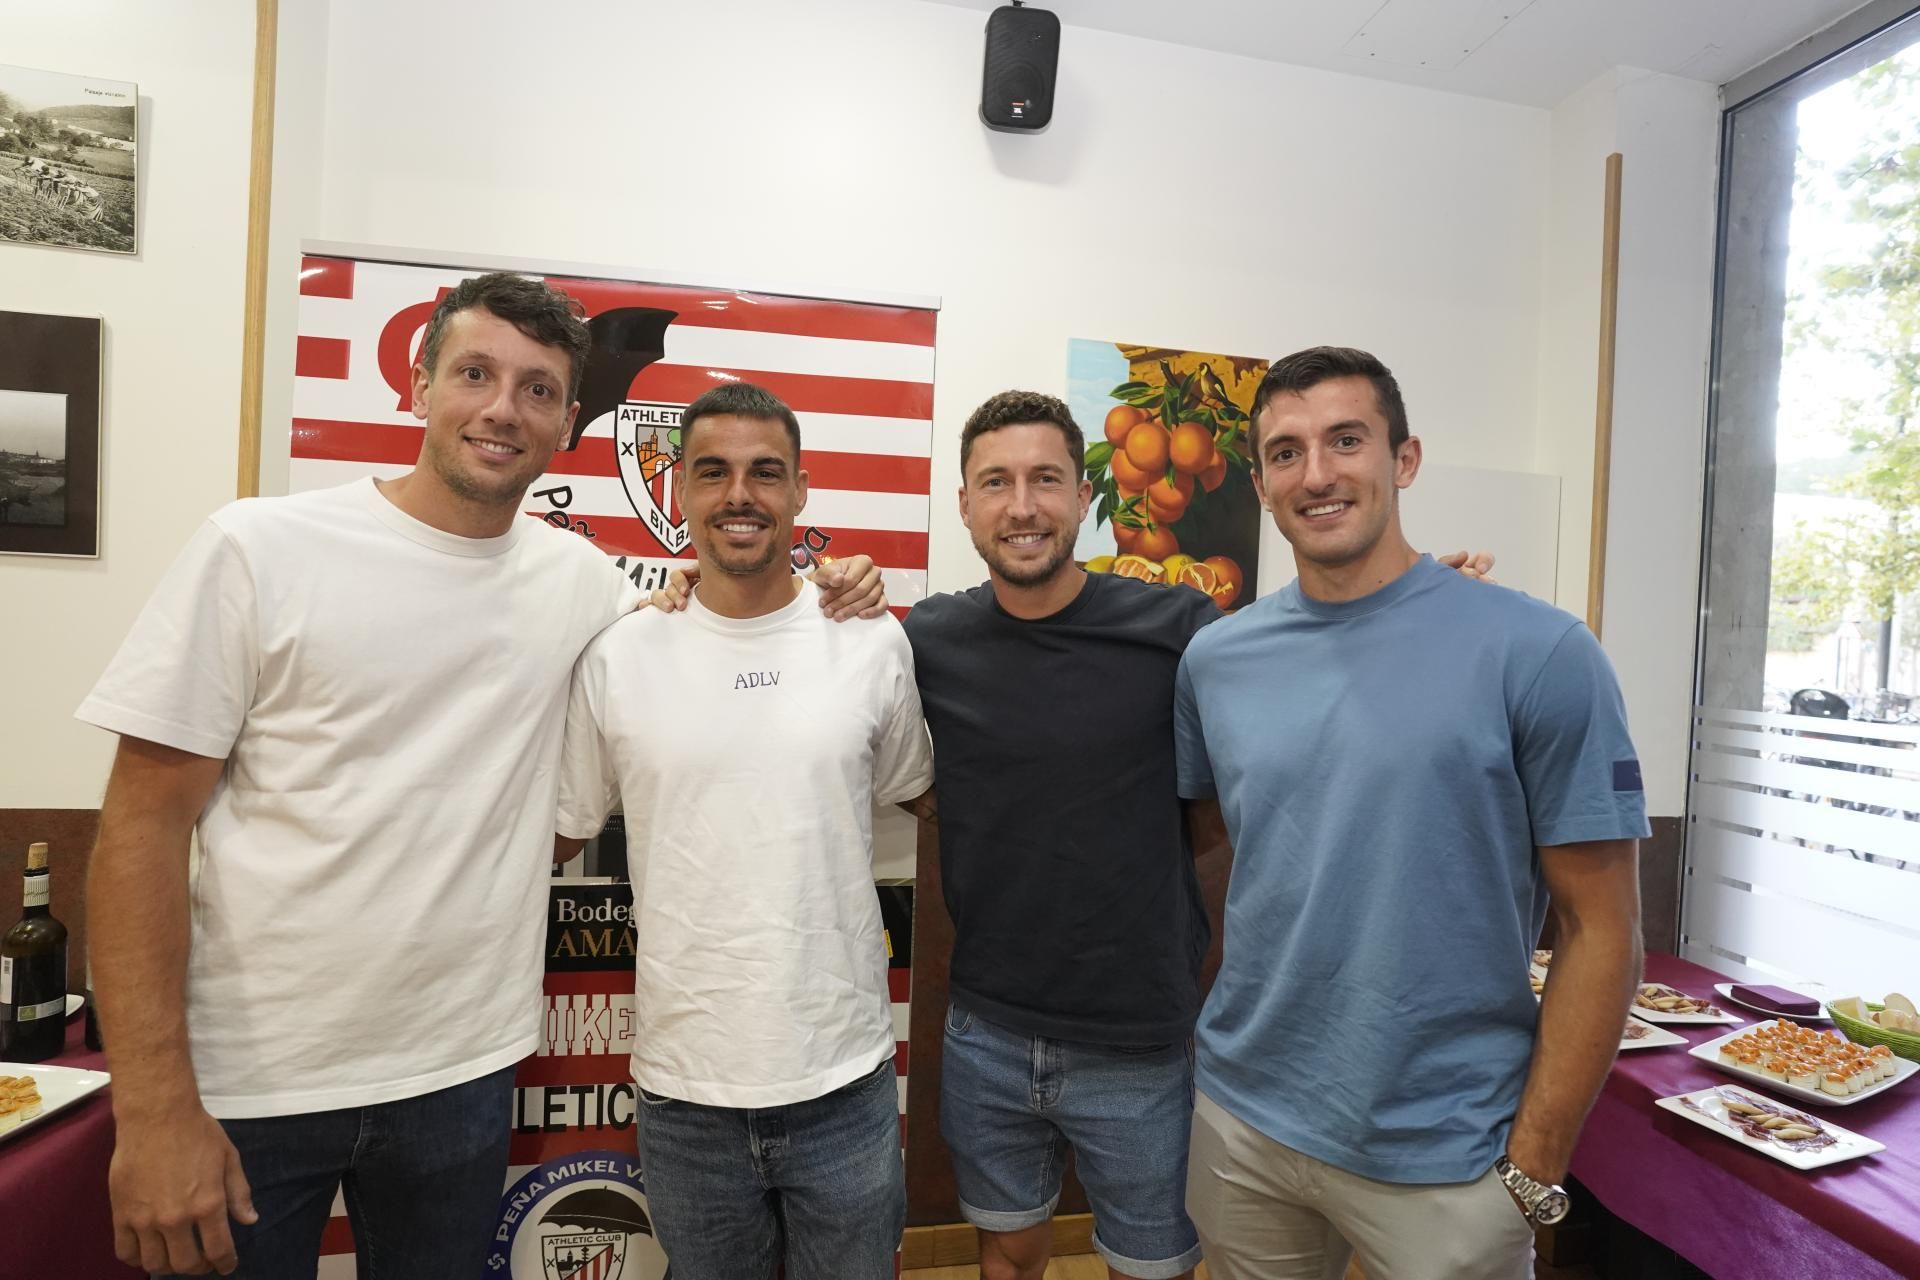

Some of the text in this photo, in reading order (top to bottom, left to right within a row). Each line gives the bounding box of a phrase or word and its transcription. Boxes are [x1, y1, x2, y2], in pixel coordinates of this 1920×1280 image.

[791, 526, 832, 574] ga
[734, 671, 780, 690] ADLV
[516, 1082, 635, 1135] LETIC
[495, 1181, 546, 1242] PEÑA
[546, 1159, 620, 1185] MIKEL
[547, 1234, 622, 1246] ATHLETIC CLUB
